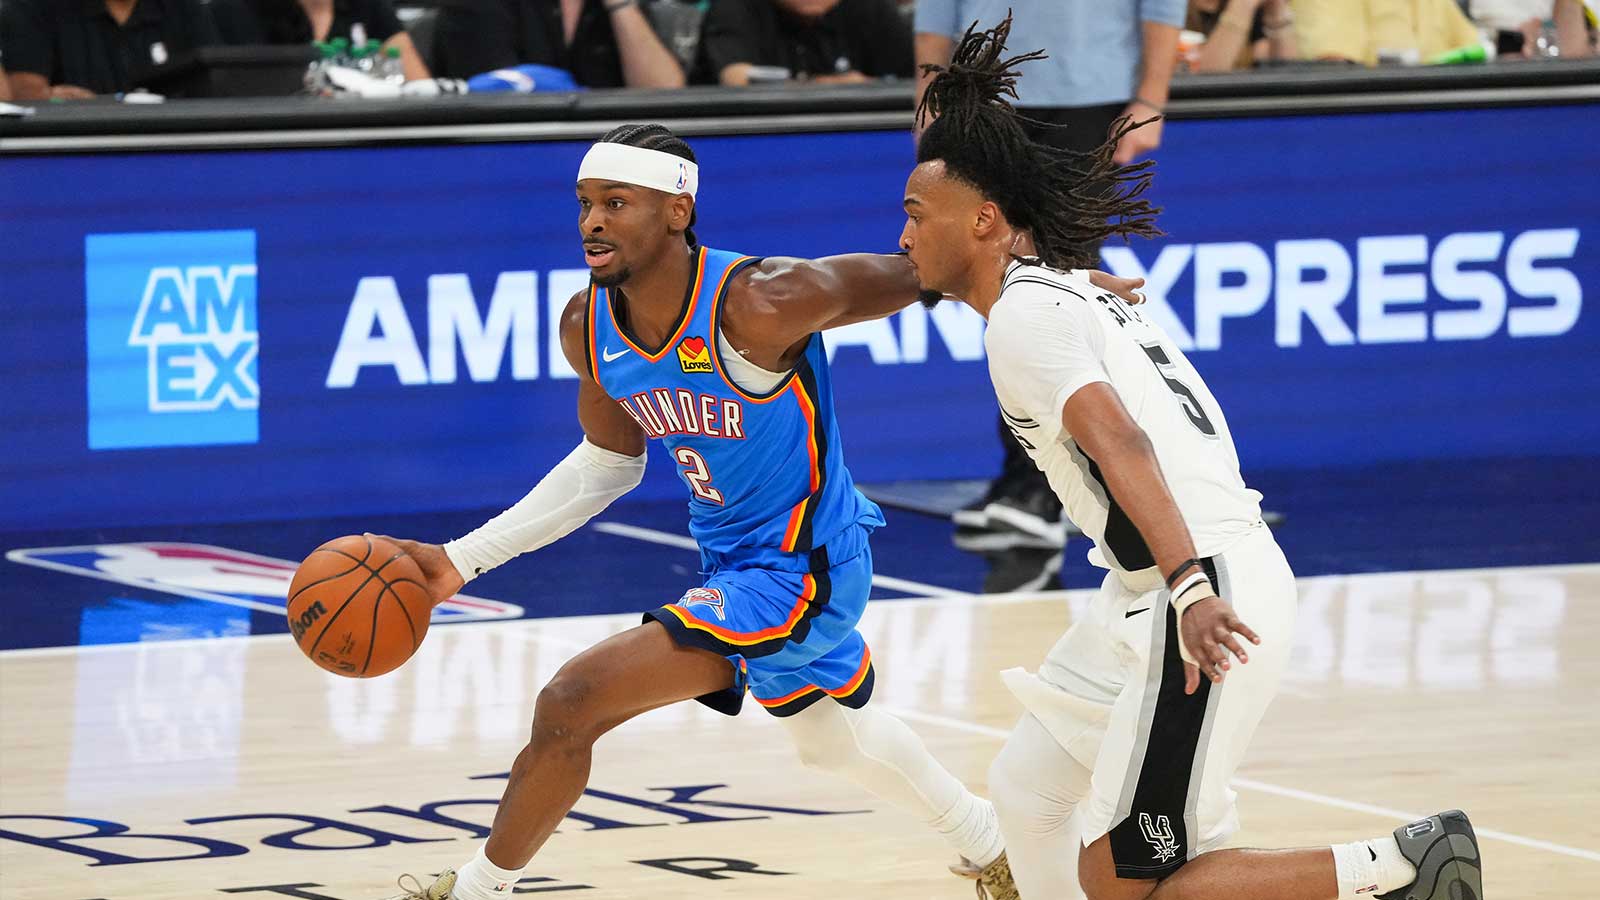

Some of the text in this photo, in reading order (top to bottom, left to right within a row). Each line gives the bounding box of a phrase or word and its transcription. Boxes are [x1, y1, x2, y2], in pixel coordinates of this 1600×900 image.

[1099, 228, 1583, 351] XPRESS
[616, 387, 746, 439] HUNDER
[1135, 339, 1220, 440] 5
[675, 446, 725, 507] 2
